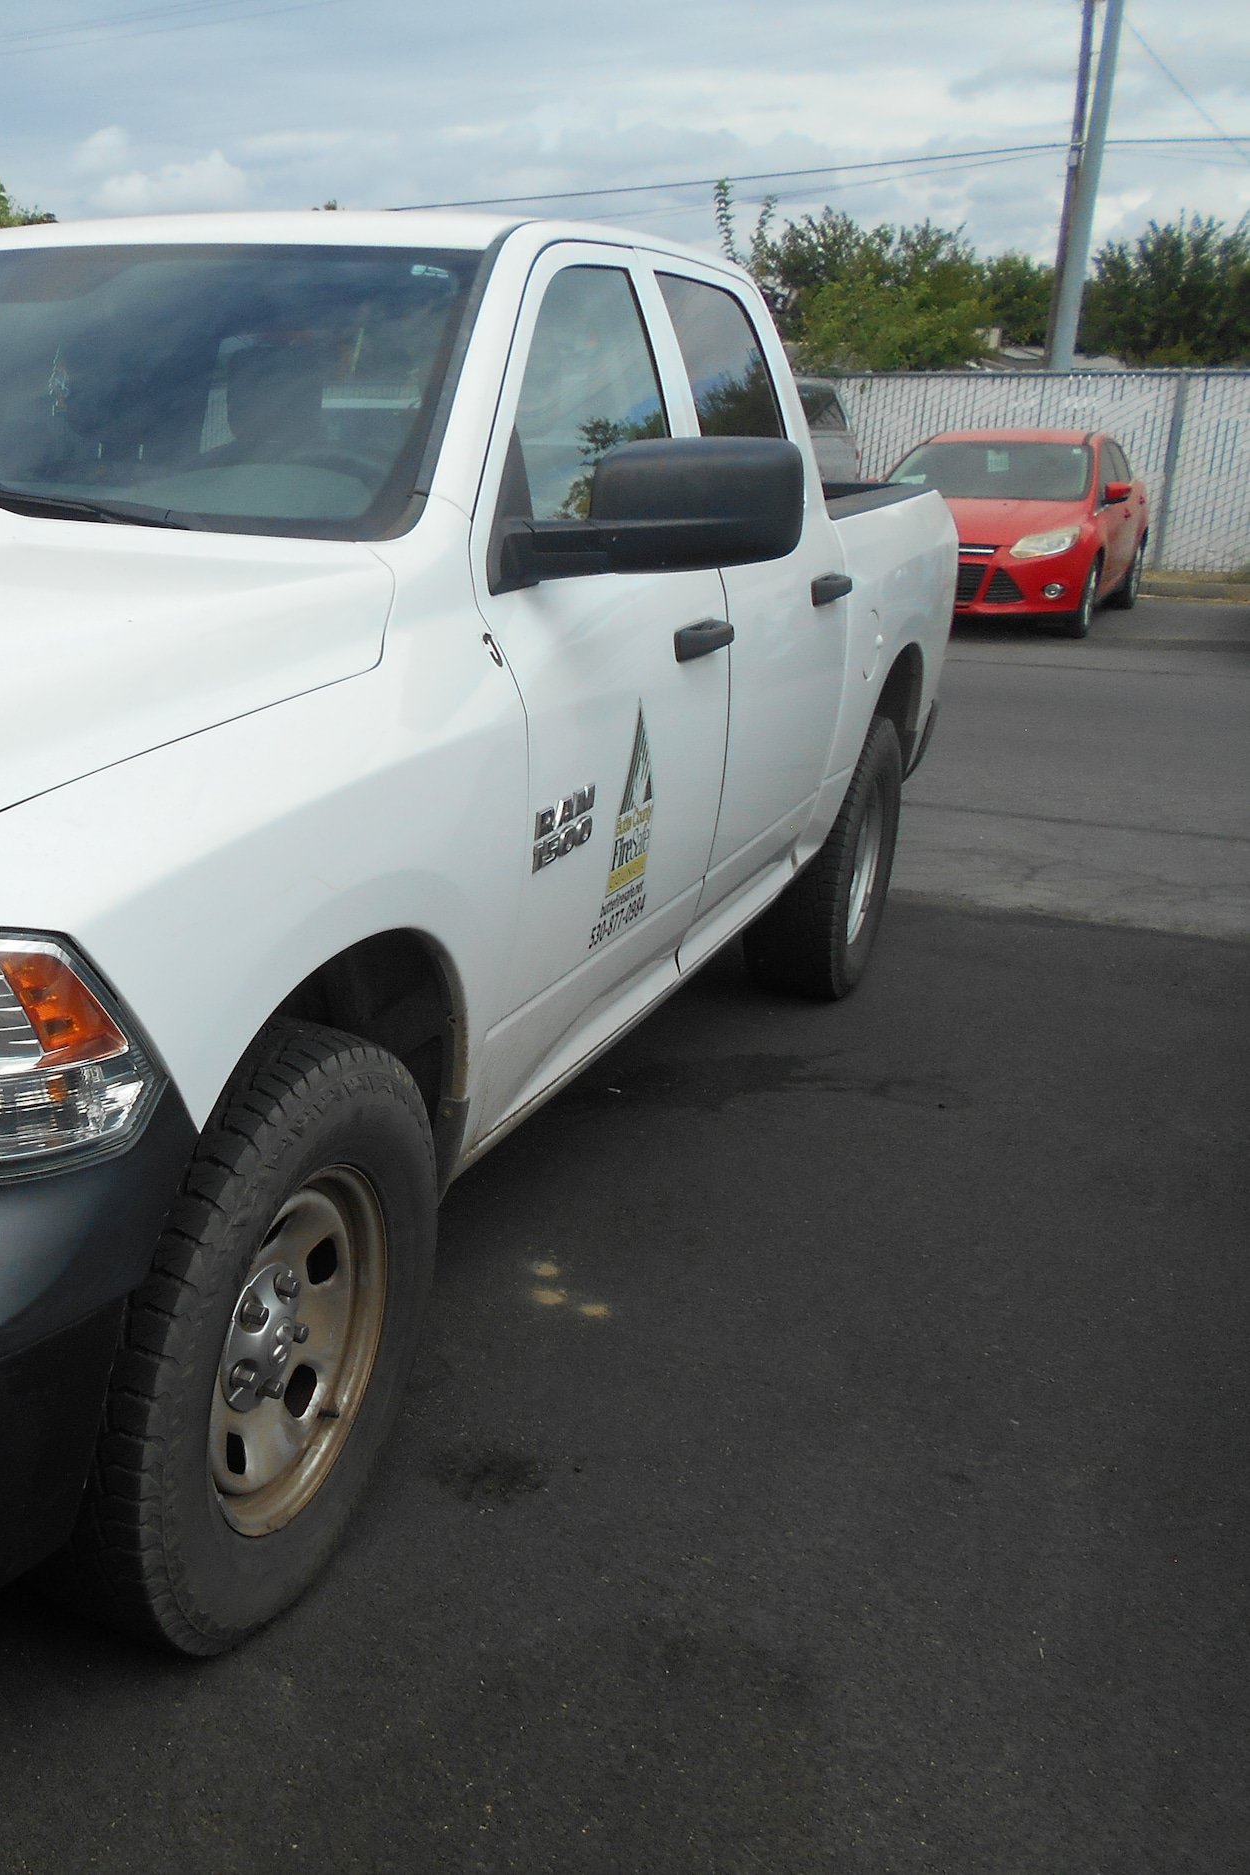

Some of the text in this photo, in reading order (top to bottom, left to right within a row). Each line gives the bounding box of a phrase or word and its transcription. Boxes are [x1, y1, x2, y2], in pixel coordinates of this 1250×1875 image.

[534, 783, 596, 841] RAM
[531, 815, 593, 874] 1500
[588, 893, 647, 950] 530-877-0984
